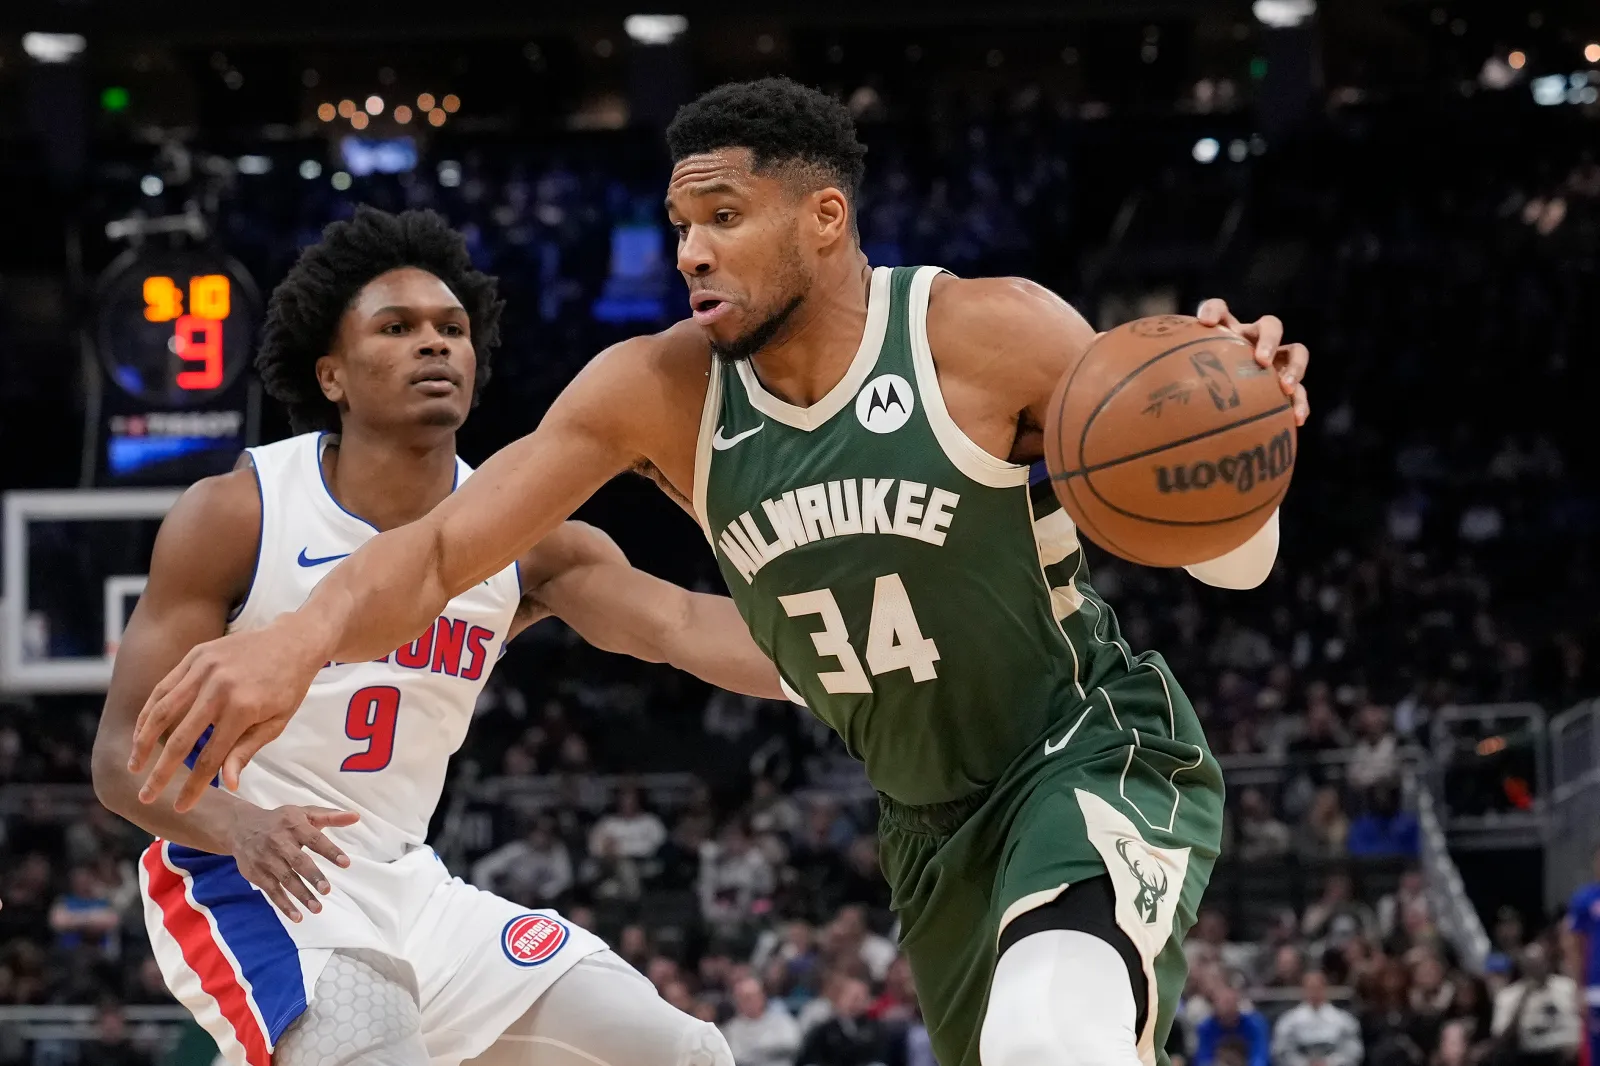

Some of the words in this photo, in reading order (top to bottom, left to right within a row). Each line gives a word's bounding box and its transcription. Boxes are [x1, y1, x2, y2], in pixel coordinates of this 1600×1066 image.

[174, 314, 223, 389] 9
[1155, 428, 1293, 494] Wilson
[718, 477, 961, 585] MILWAUKEE
[777, 572, 941, 694] 34
[339, 685, 401, 773] 9
[513, 919, 549, 950] DETROIT
[521, 923, 557, 956] PISTONS
